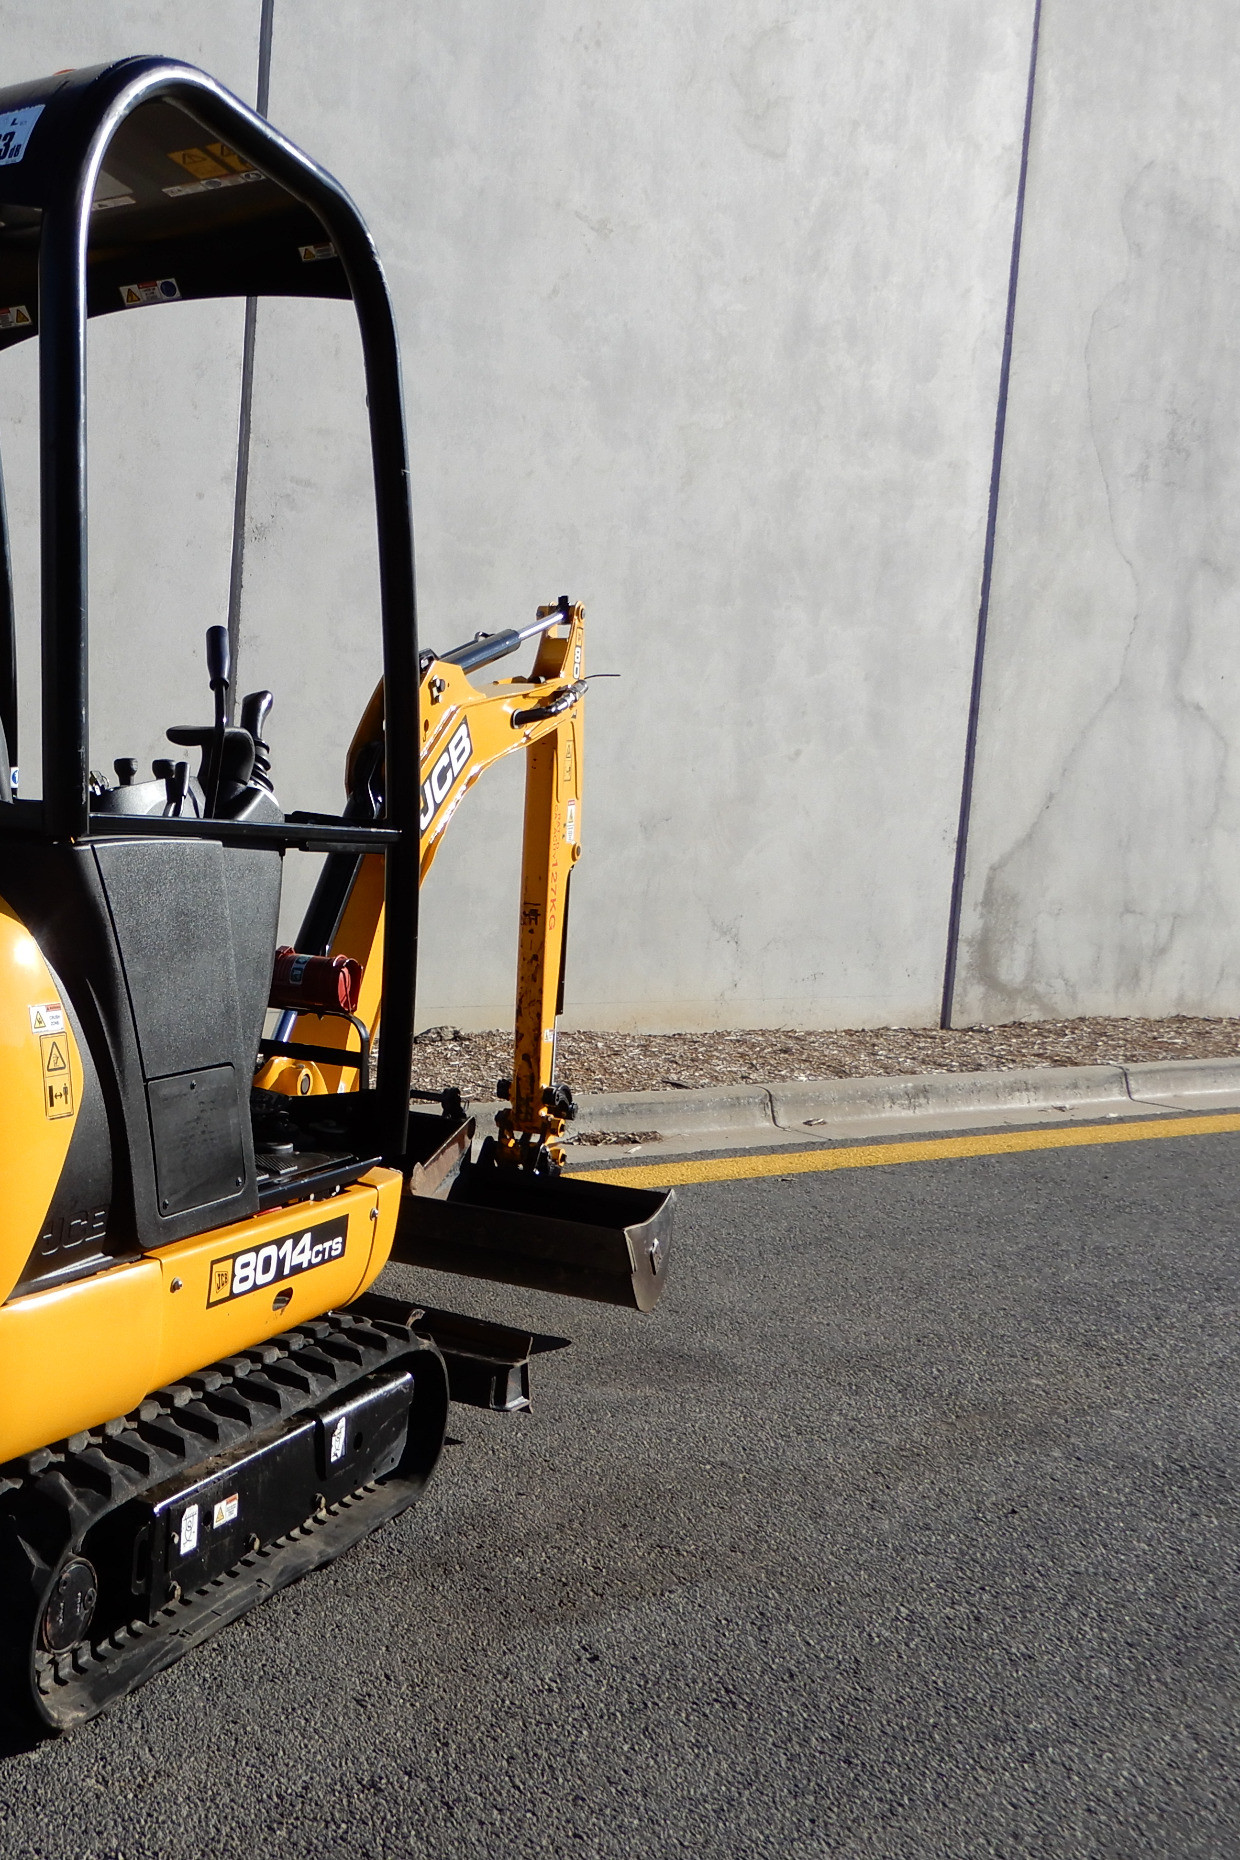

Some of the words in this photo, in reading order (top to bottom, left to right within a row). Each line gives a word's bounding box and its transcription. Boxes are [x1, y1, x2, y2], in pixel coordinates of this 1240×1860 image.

[420, 723, 471, 831] JCB
[216, 1273, 228, 1290] JCB
[232, 1232, 312, 1294] 8014
[312, 1237, 342, 1264] CTS
